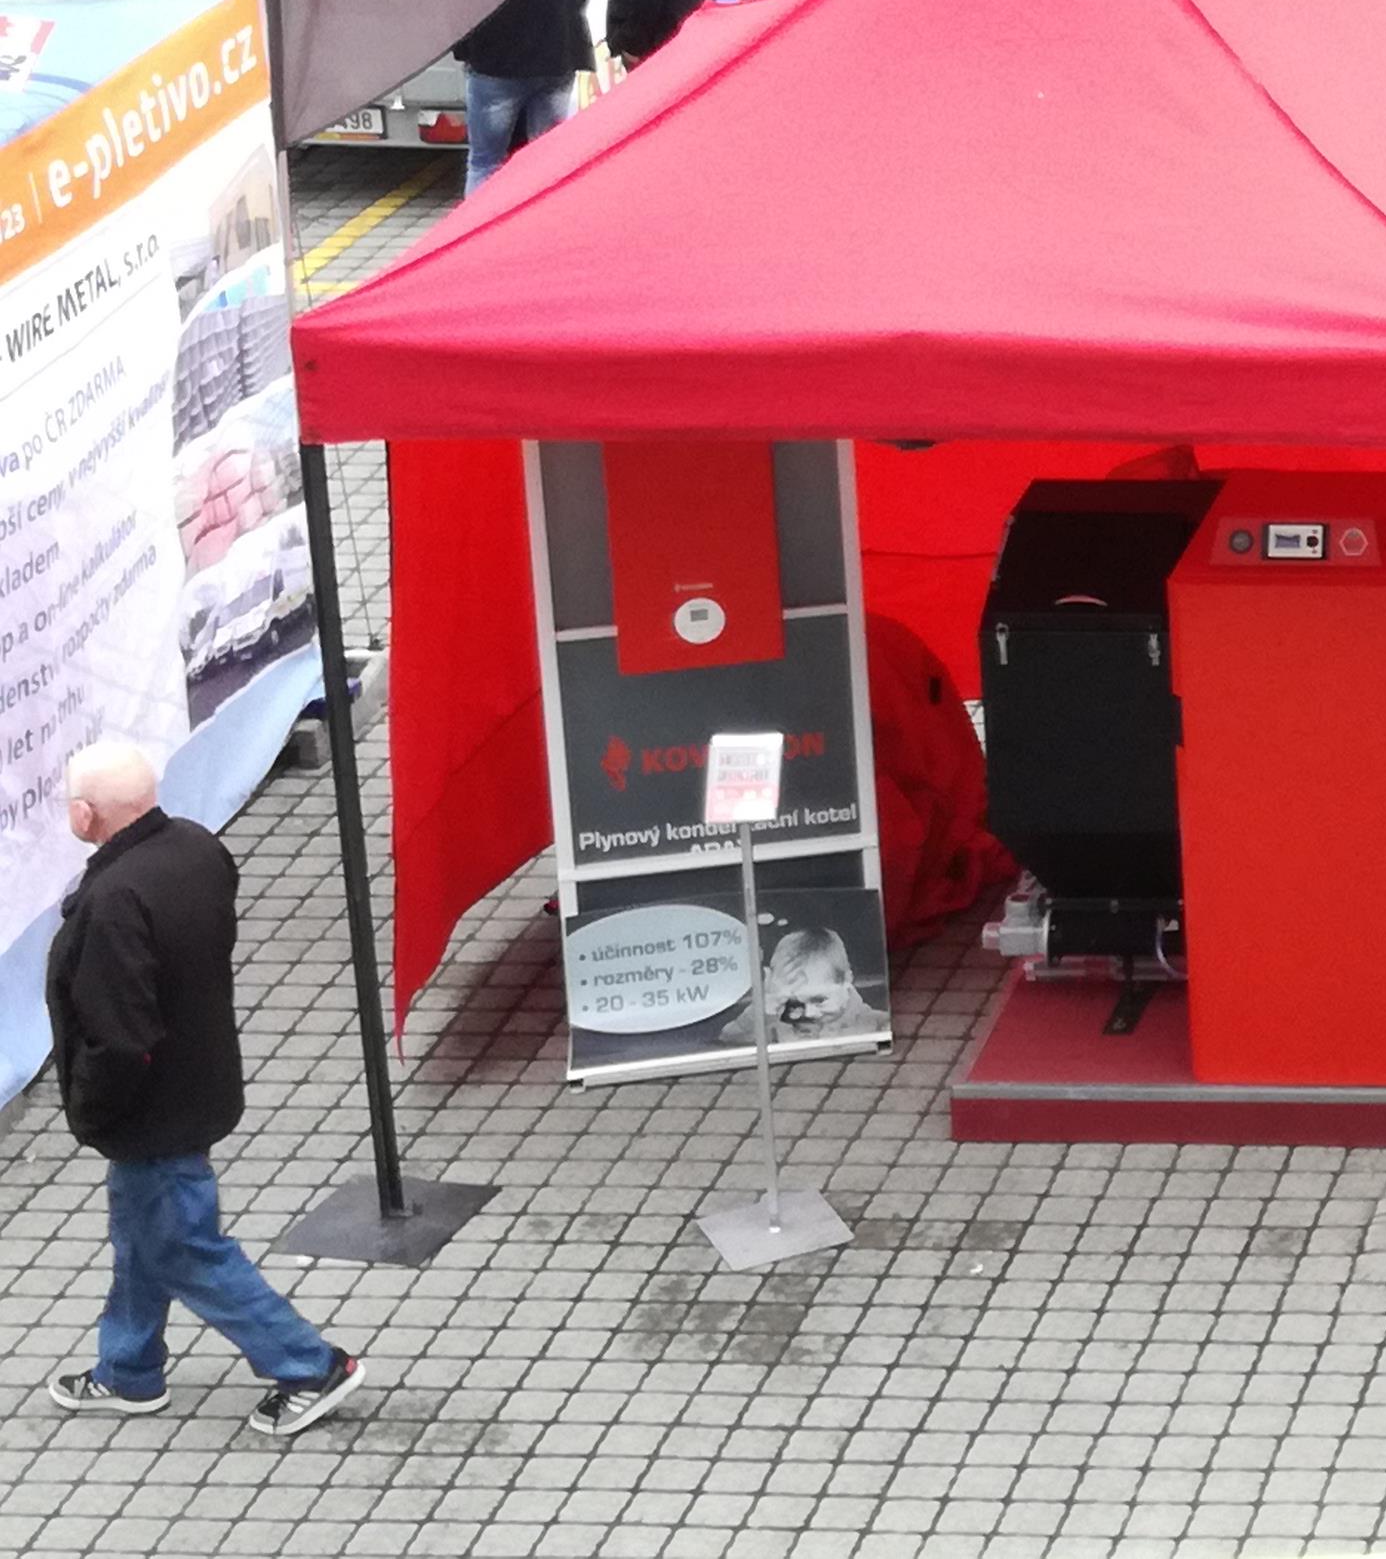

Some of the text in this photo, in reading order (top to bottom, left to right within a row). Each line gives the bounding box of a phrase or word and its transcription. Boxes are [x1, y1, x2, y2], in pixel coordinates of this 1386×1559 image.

[47, 24, 257, 208] e-pletivo.cz
[5, 303, 55, 364] WIRE
[22, 434, 43, 472] po
[45, 408, 68, 444] ČR
[67, 354, 127, 427] ZDARMA
[578, 824, 661, 858] Plynový
[804, 806, 857, 826] kotel
[591, 929, 743, 962] účinnost 107%
[593, 966, 675, 988] rozměry
[690, 956, 739, 976] 28%
[595, 995, 625, 1014] 20
[641, 989, 670, 1008] 35
[676, 984, 710, 1003] kW
